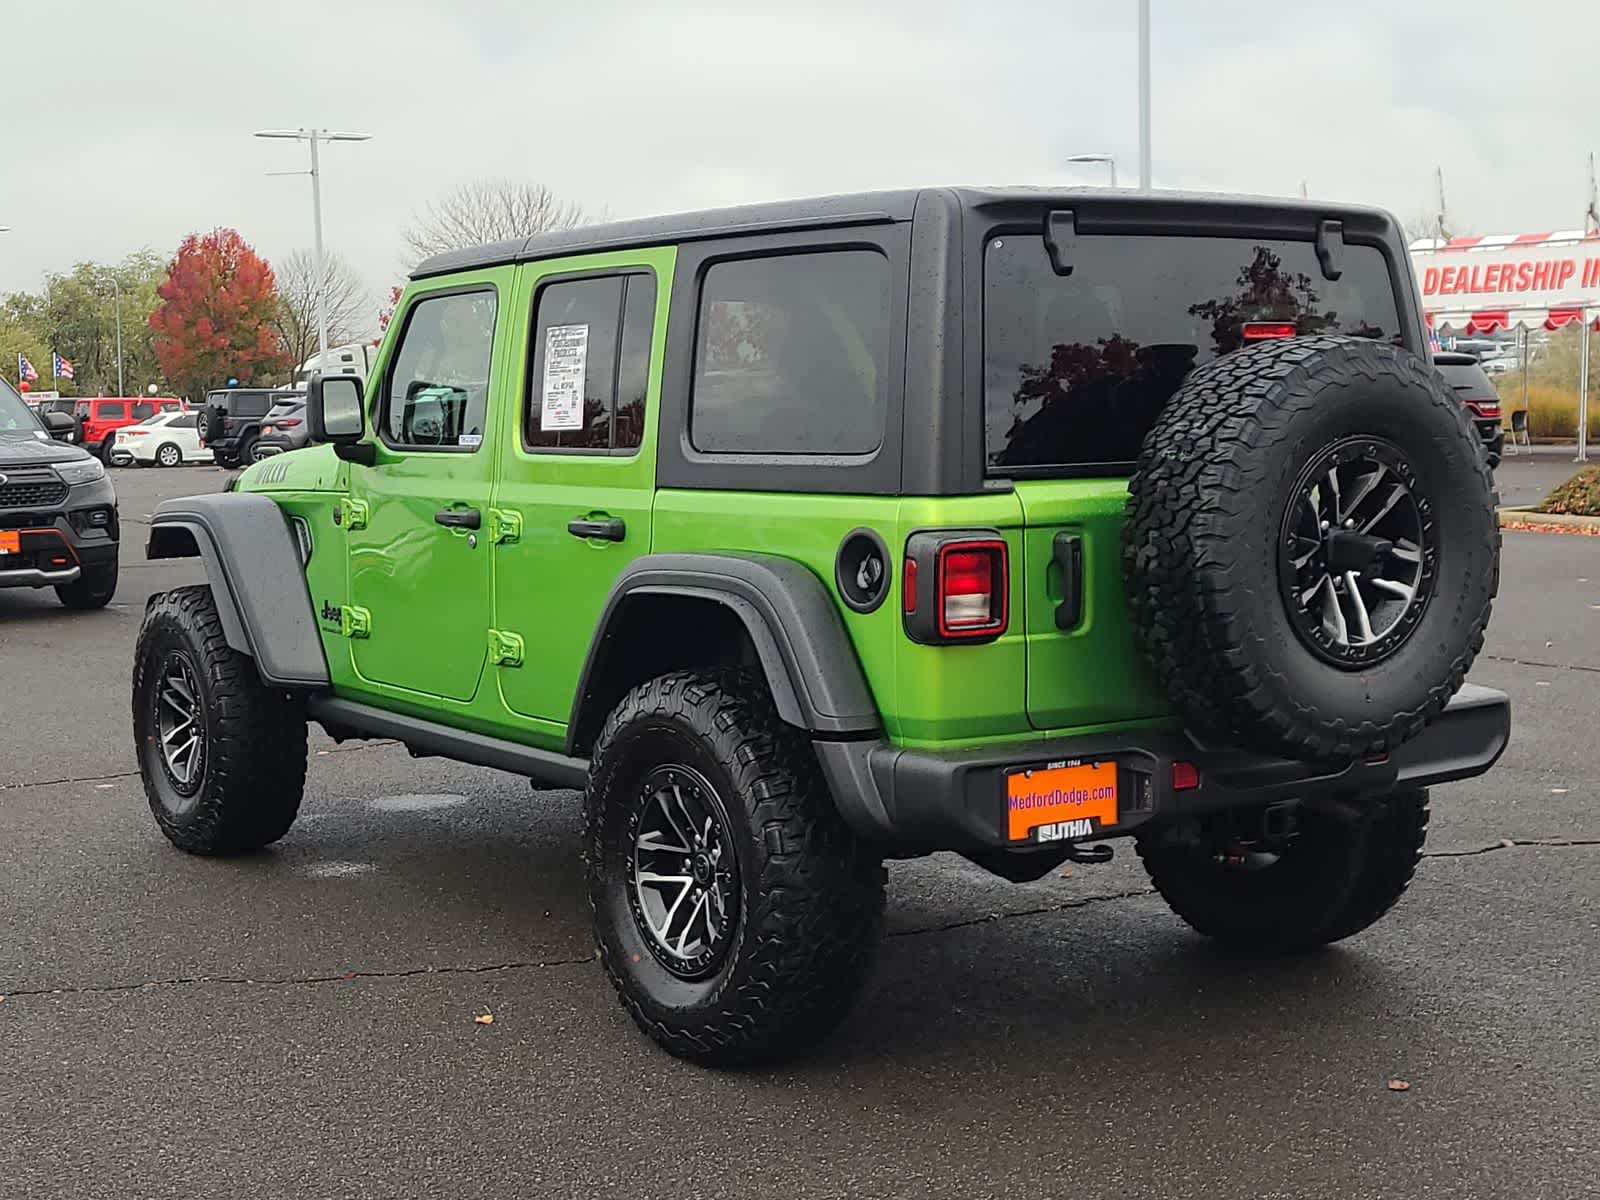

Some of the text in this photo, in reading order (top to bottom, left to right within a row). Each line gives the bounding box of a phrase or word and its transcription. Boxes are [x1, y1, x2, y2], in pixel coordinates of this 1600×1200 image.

[1423, 258, 1576, 296] DEALERSHIP
[1008, 786, 1115, 812] MedfordDodge.com
[1051, 818, 1094, 841] LITHIA
